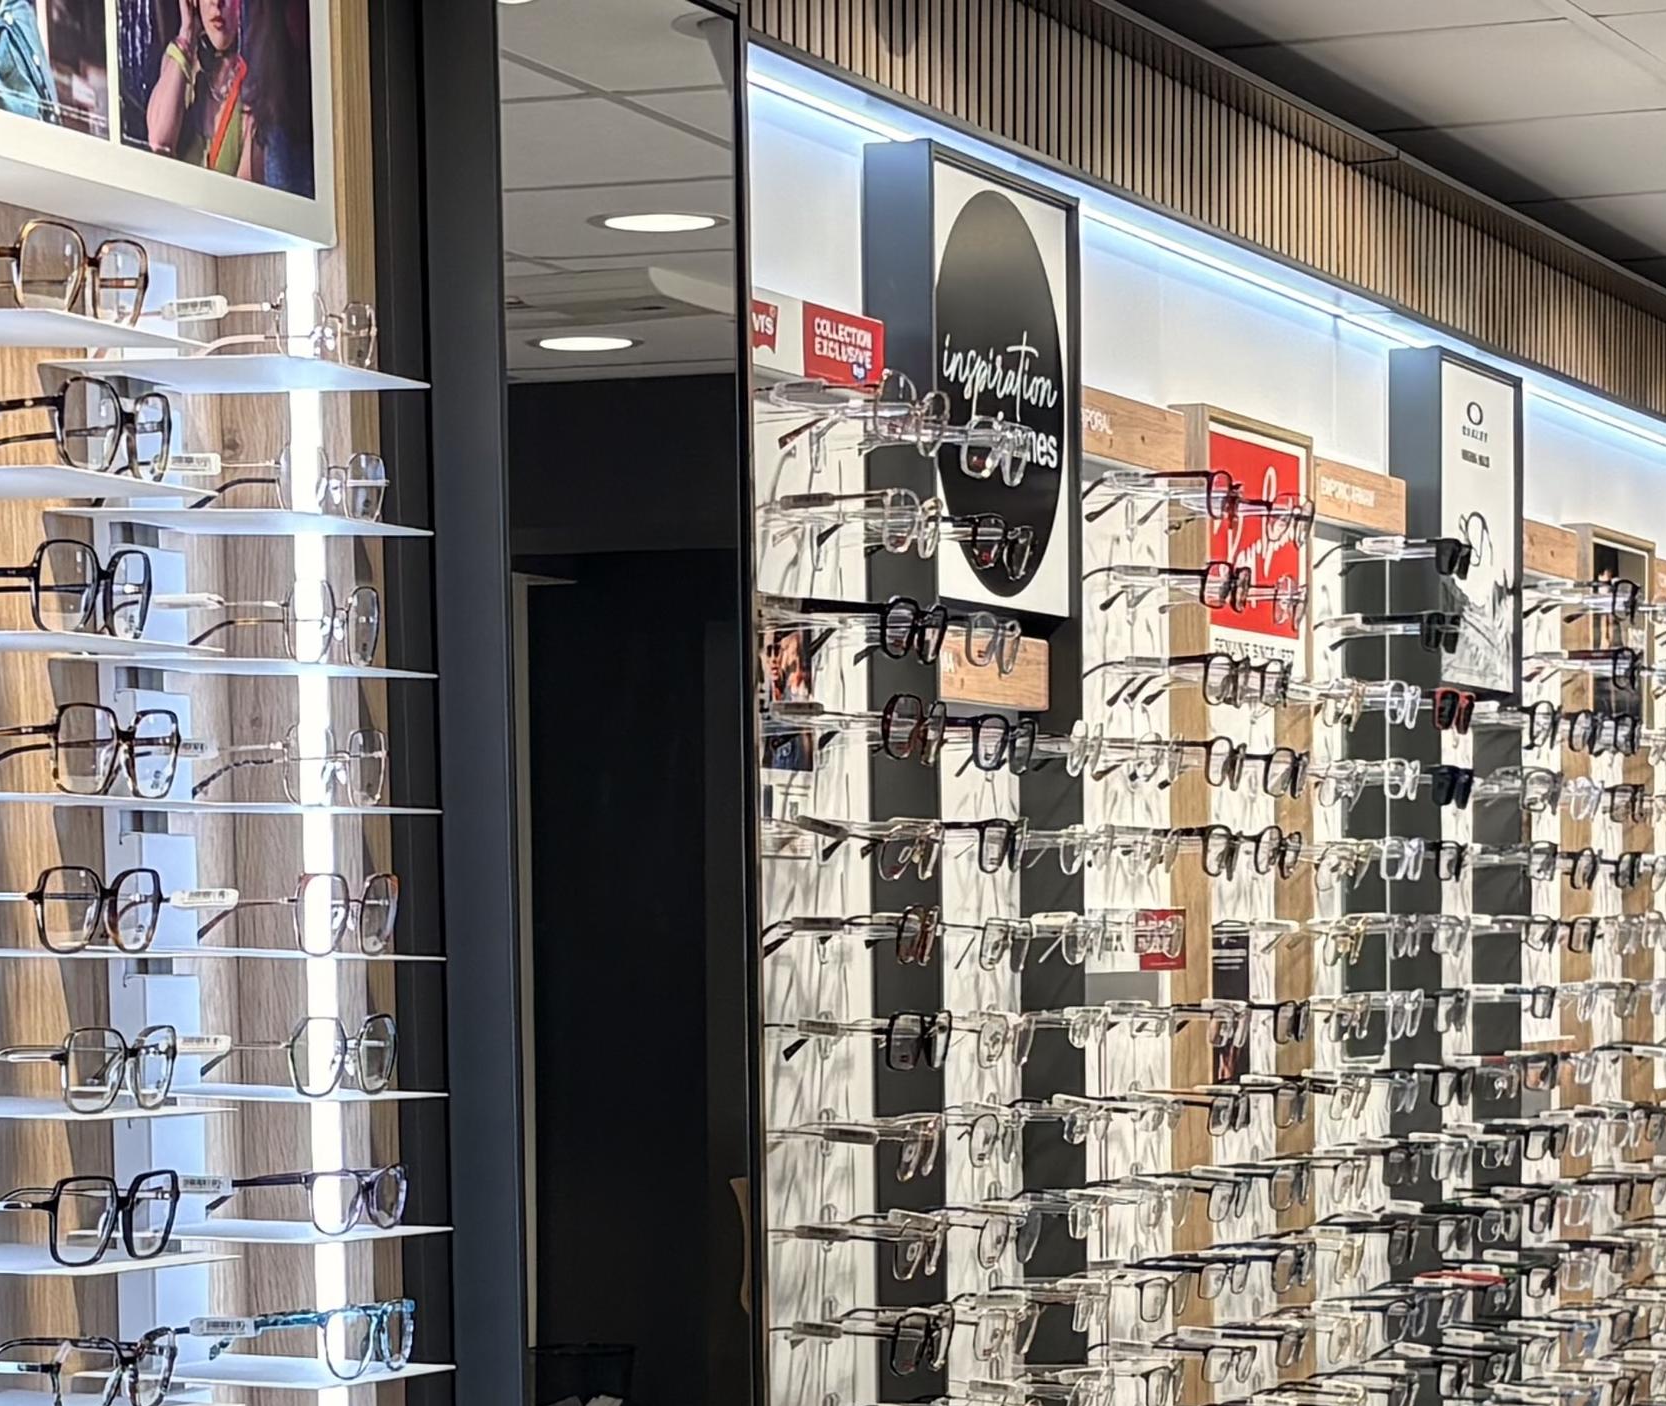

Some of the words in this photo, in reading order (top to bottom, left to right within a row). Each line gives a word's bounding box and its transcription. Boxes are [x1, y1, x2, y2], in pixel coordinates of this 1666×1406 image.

[814, 316, 872, 350] COLLECTION
[814, 336, 872, 370] EXCLUSIVE
[942, 330, 1058, 424] inspiration
